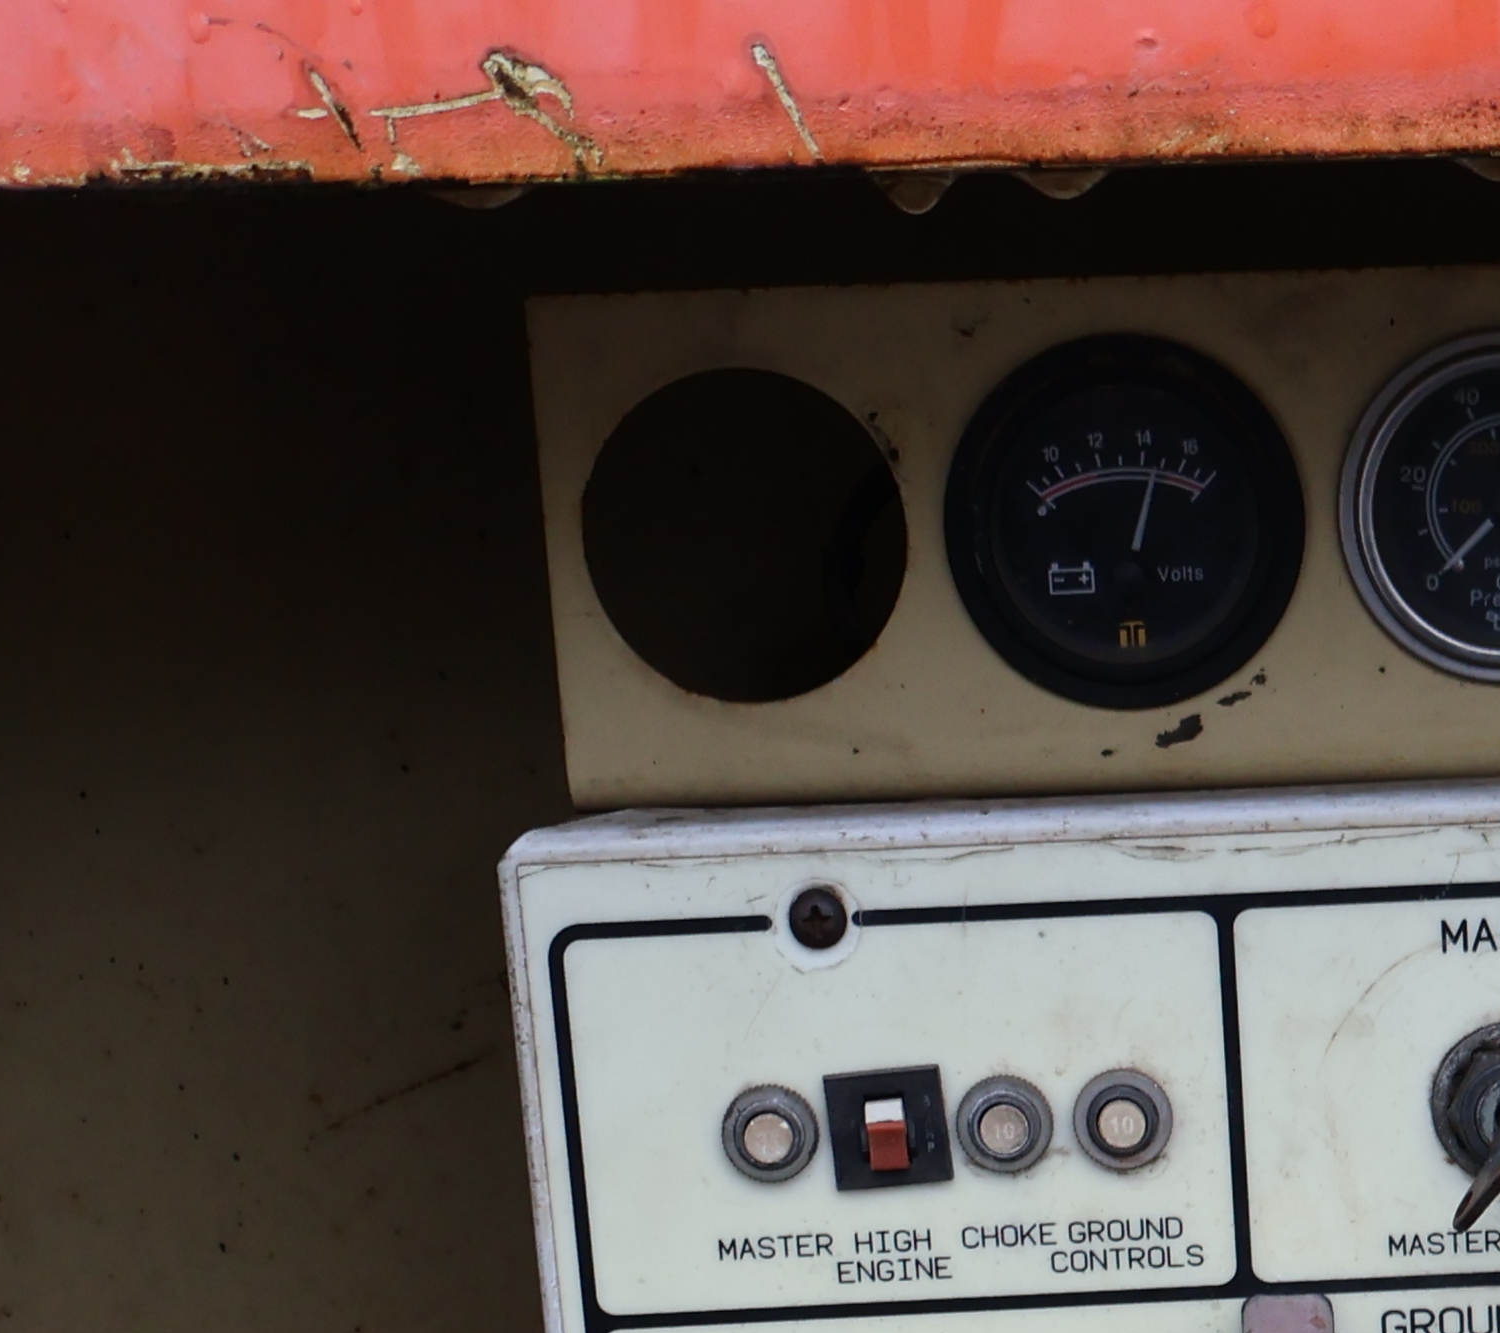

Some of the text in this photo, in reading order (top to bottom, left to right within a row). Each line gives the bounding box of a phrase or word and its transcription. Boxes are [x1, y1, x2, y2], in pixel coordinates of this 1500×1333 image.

[1454, 388, 1480, 405] 40
[1087, 432, 1104, 448] 12
[1135, 431, 1152, 447] 14
[1182, 438, 1198, 454] 16
[1042, 445, 1060, 462] 10
[1400, 467, 1426, 484] 20
[1157, 565, 1204, 582] Volts
[1425, 575, 1438, 591] 0
[718, 1217, 1183, 1260] MASTER HIGH CHOKE GROUND
[1051, 1245, 1204, 1273] CONTROLS
[837, 1257, 952, 1284] ENGINE
